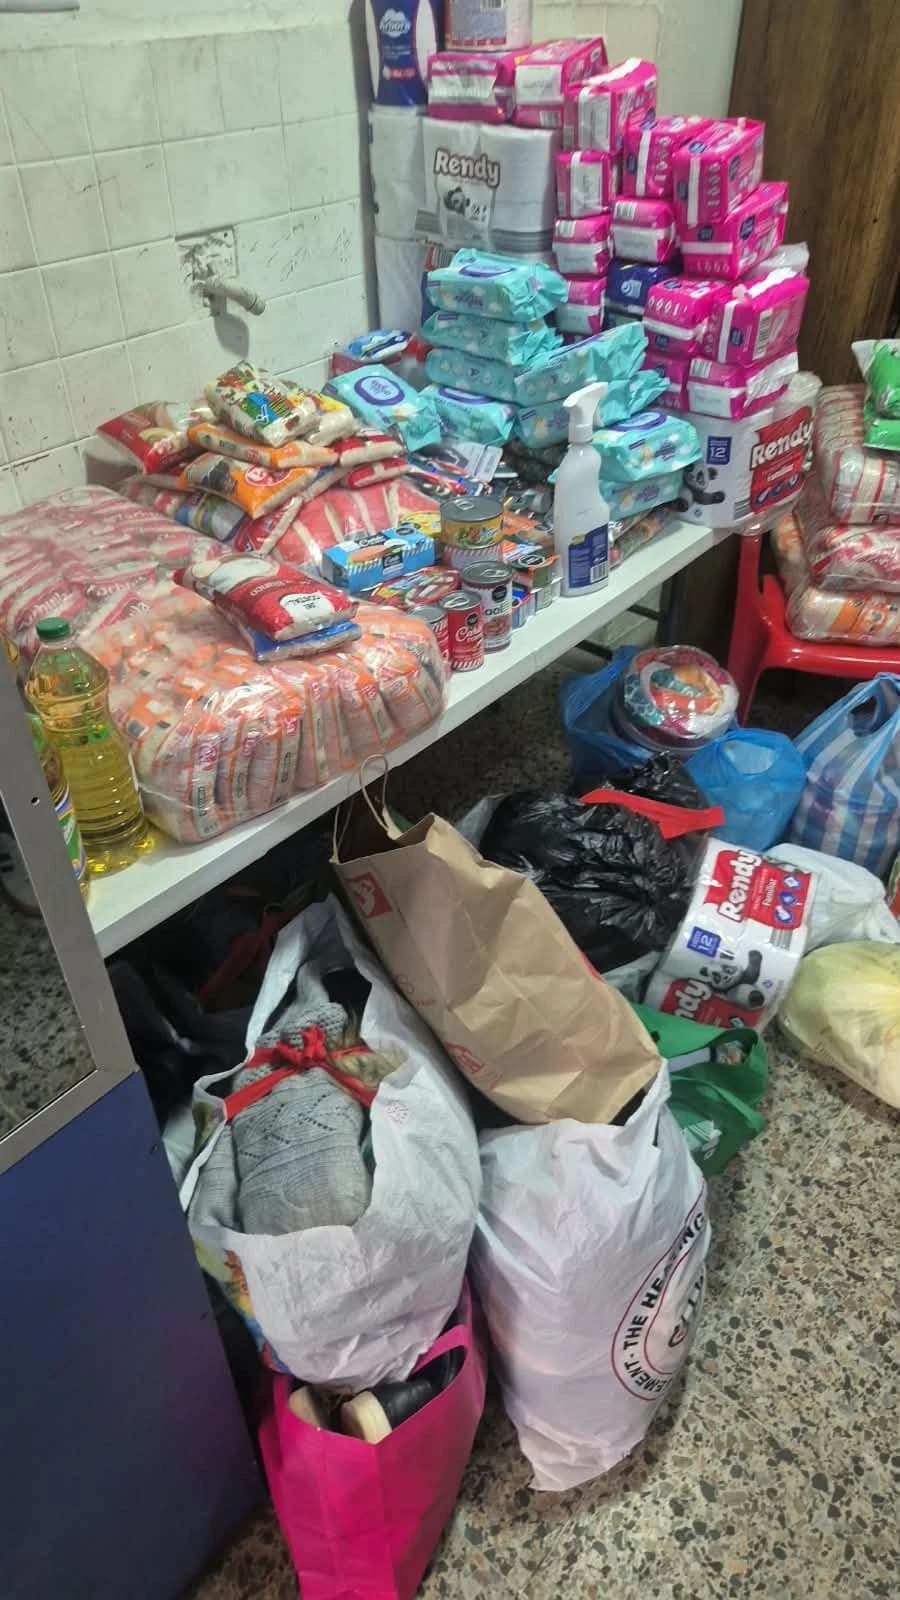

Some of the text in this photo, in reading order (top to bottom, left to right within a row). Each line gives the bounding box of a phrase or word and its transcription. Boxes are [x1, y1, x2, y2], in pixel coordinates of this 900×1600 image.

[434, 148, 500, 188] Rendy
[710, 447, 727, 458] 12
[750, 420, 814, 471] Rendy
[717, 849, 763, 923] Rendy
[700, 935, 713, 951] 12
[675, 978, 712, 1018] ndy
[641, 1212, 704, 1309] HENG
[624, 1315, 649, 1351] THE
[624, 1358, 672, 1393] EMENT
